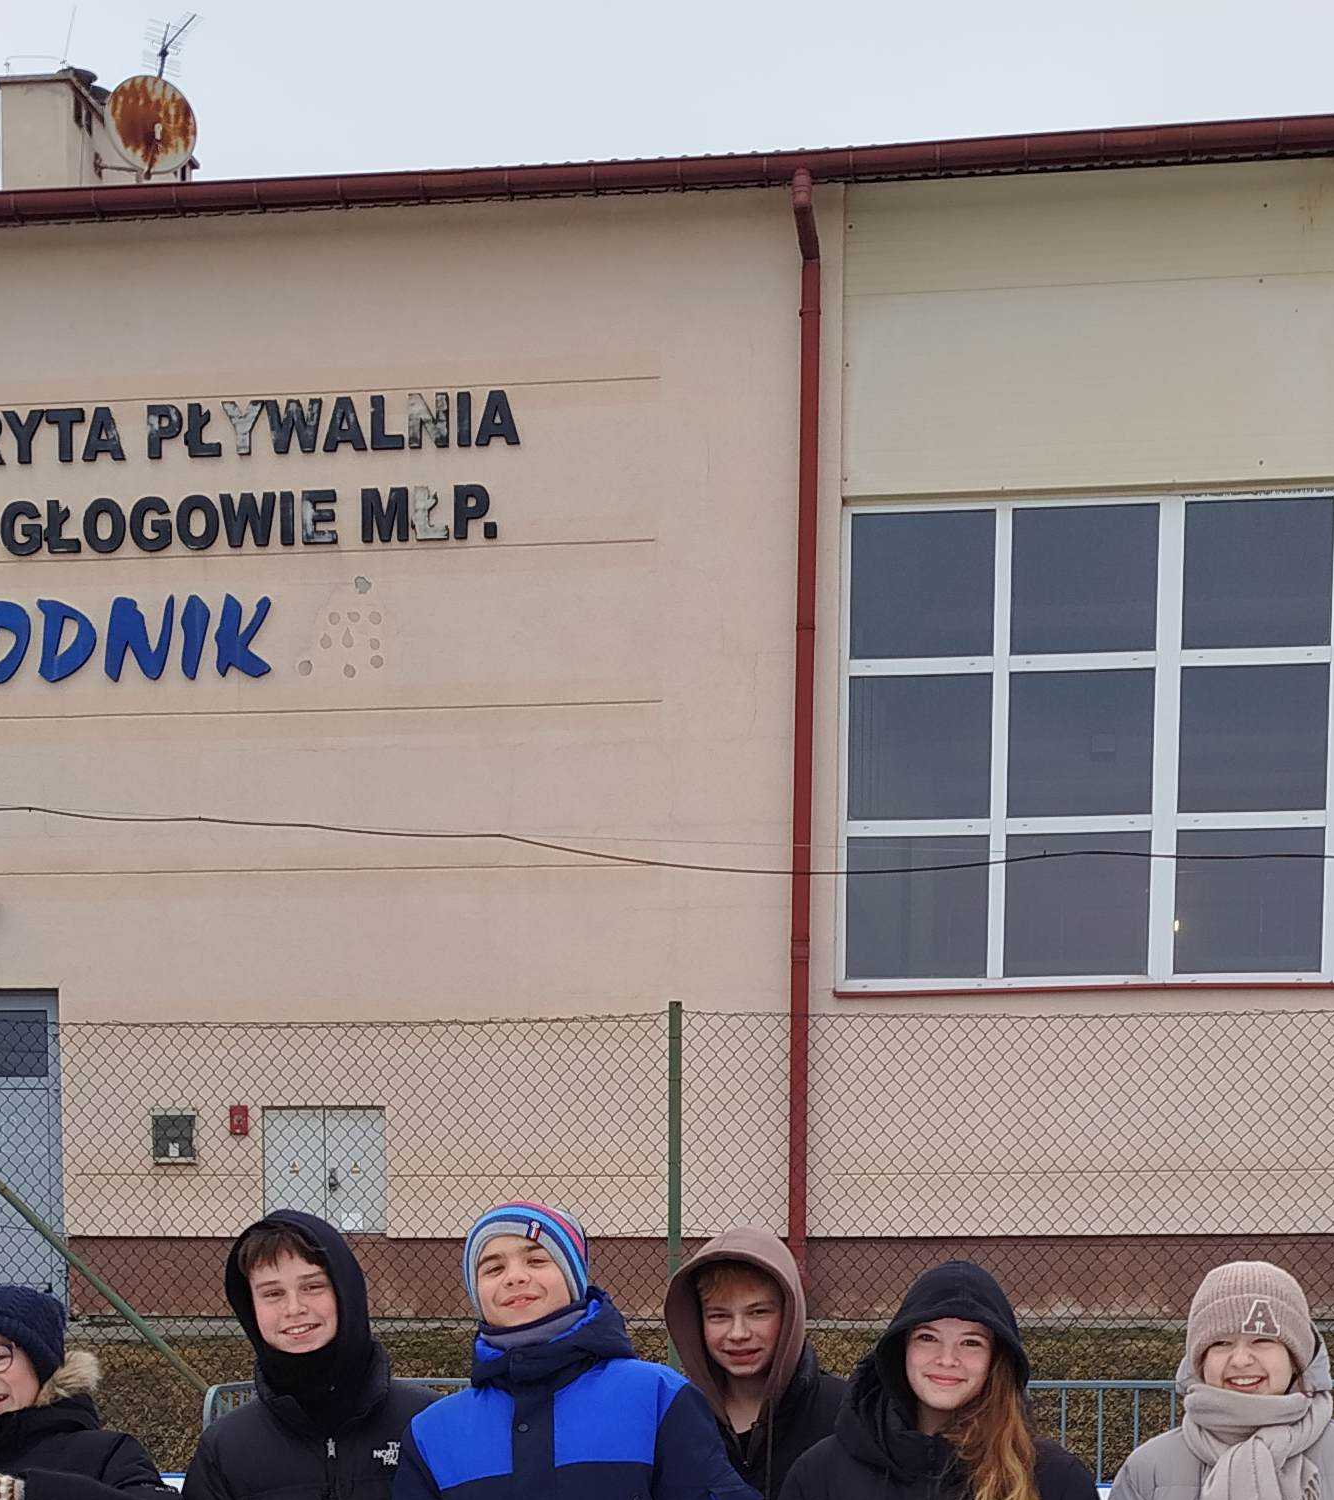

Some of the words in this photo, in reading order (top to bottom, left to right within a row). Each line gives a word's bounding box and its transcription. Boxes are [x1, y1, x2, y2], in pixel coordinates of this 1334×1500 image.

[146, 389, 521, 460] PŁYWALNIA
[0, 488, 338, 556] GŁOGOWIE
[360, 483, 498, 544] MŁP.
[1241, 1299, 1281, 1337] A
[372, 1449, 399, 1459] NORT
[386, 1441, 401, 1450] TH
